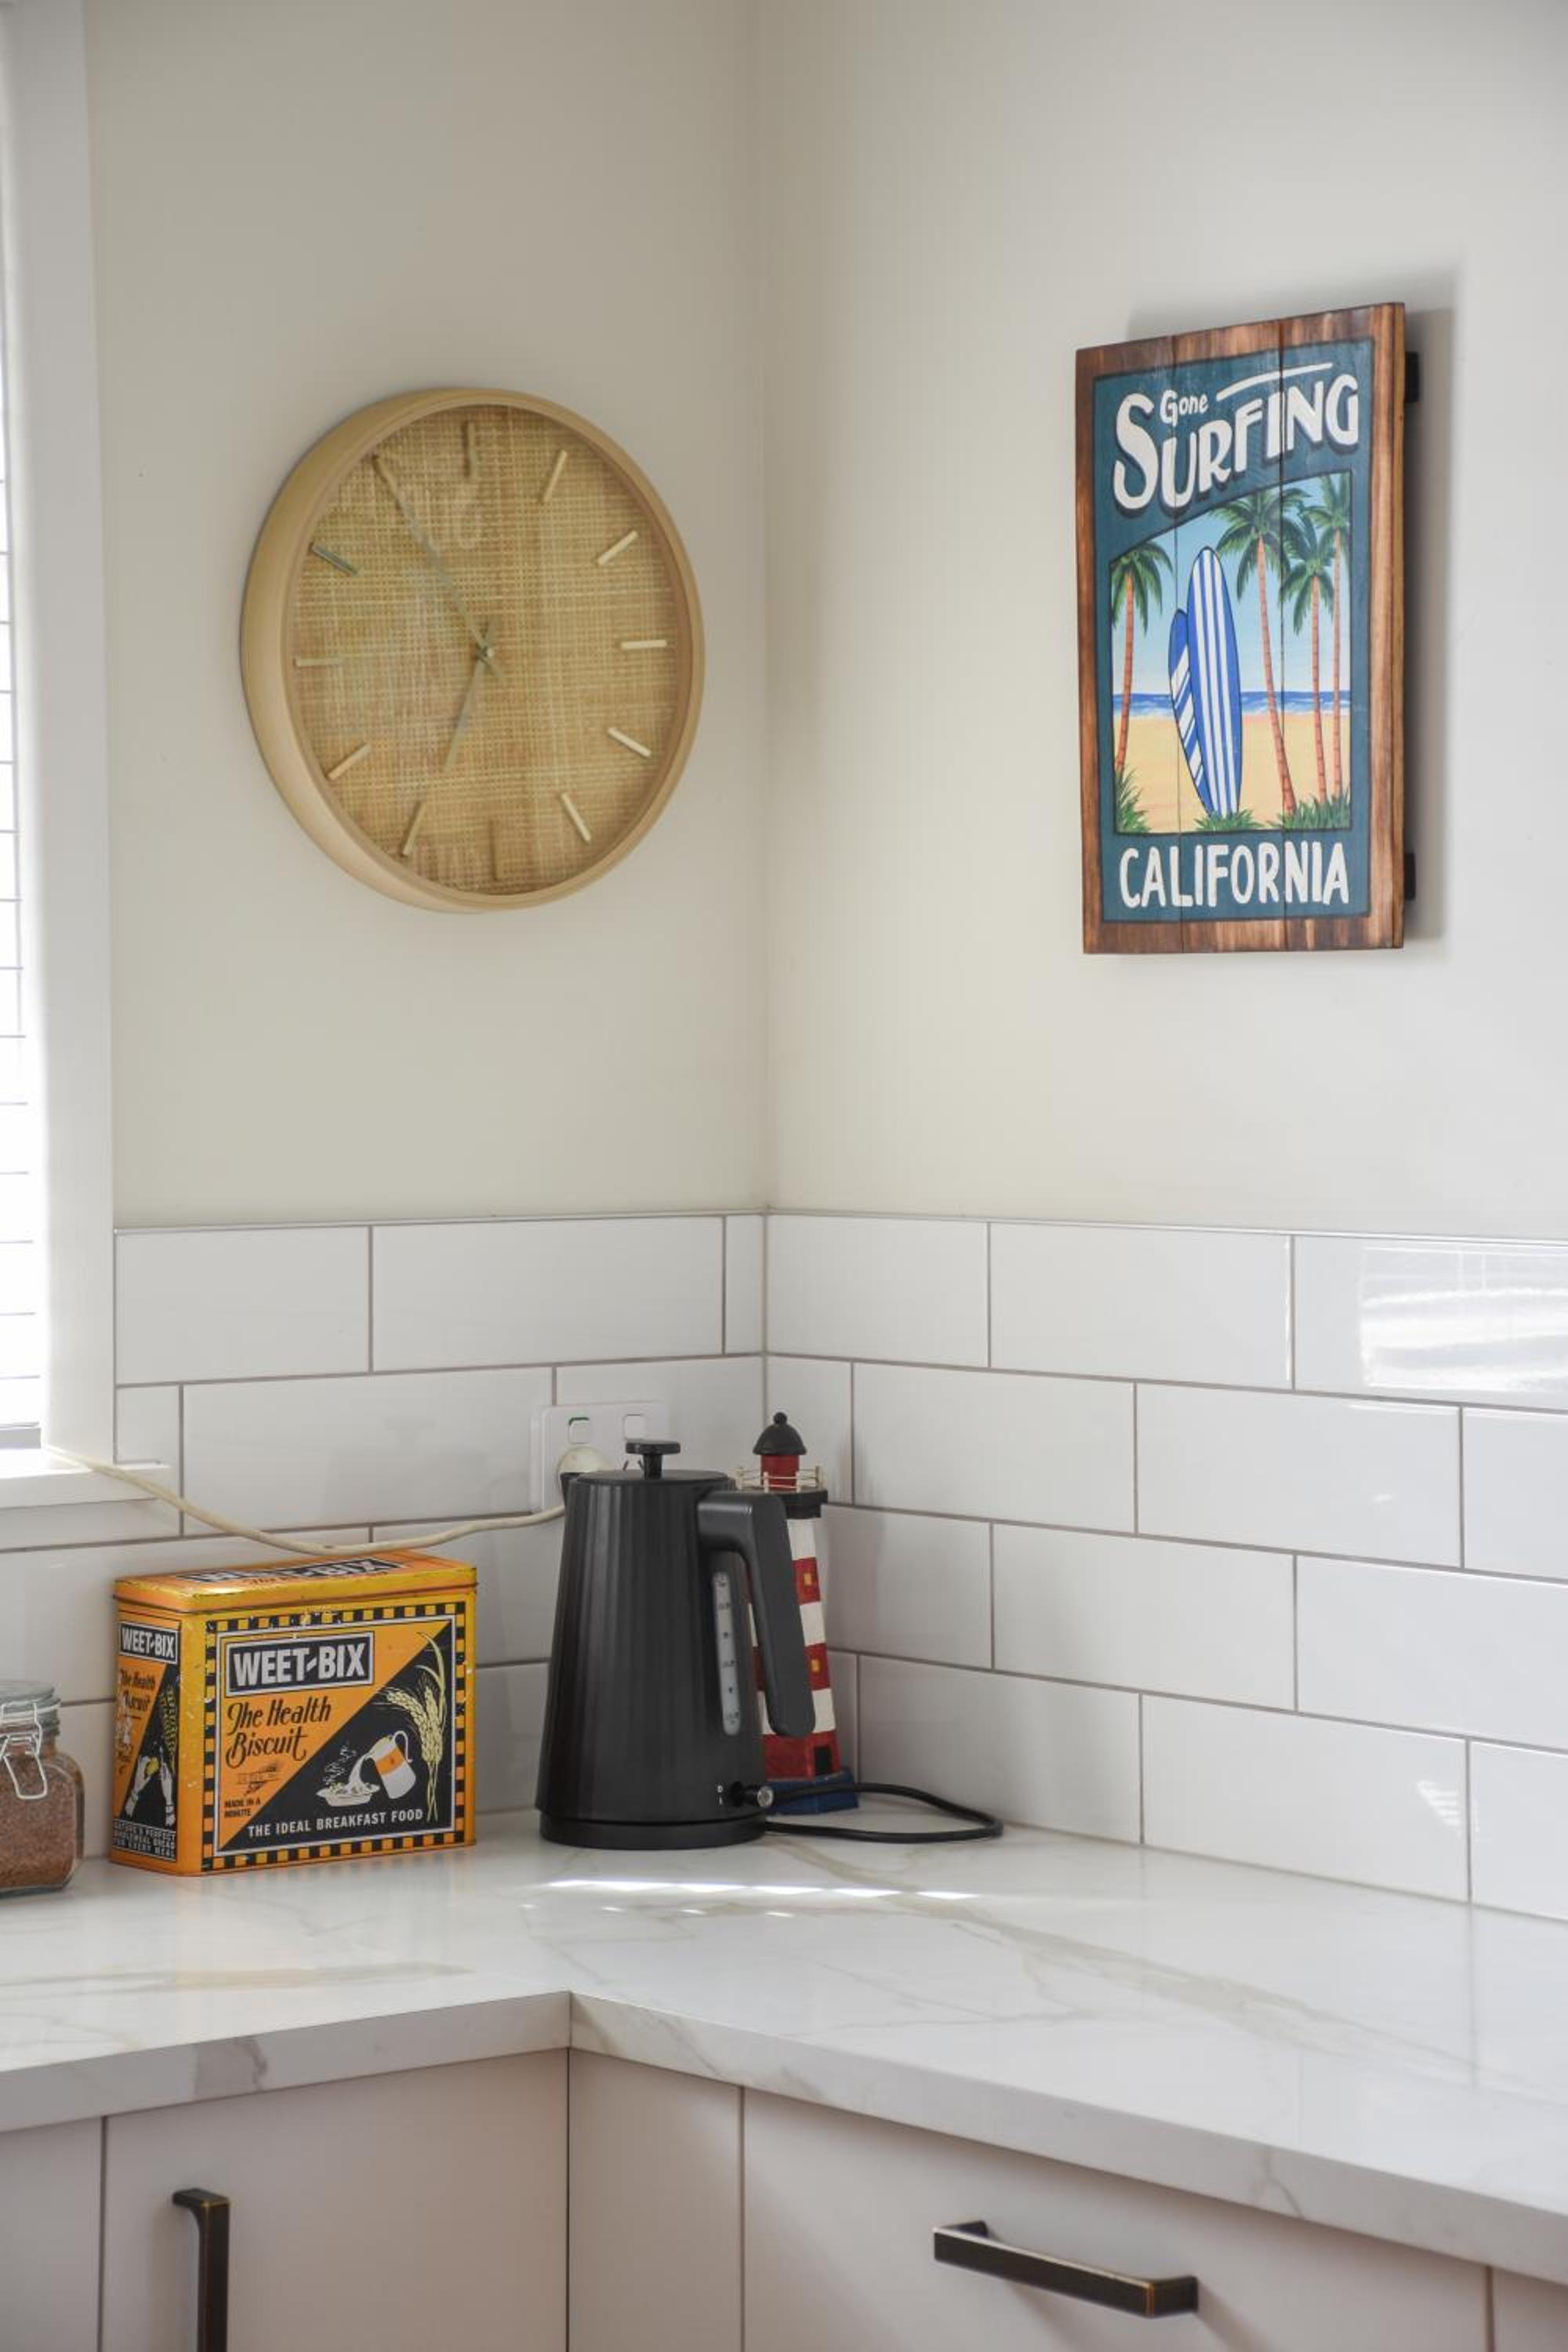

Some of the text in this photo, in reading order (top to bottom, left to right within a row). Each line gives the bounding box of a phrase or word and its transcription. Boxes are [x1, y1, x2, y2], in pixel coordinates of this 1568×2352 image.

[1160, 390, 1208, 426] Gone
[1113, 374, 1359, 510] SURFING
[1119, 840, 1349, 908] CALIFORNIA
[122, 1627, 175, 1658] WEET-BIX
[233, 1643, 365, 1686] WEET-BIX
[227, 1696, 331, 1736] The Health
[226, 1726, 308, 1769] Biscuit
[248, 1809, 423, 1838] THE IDEAL BREAKFAST FOOD
